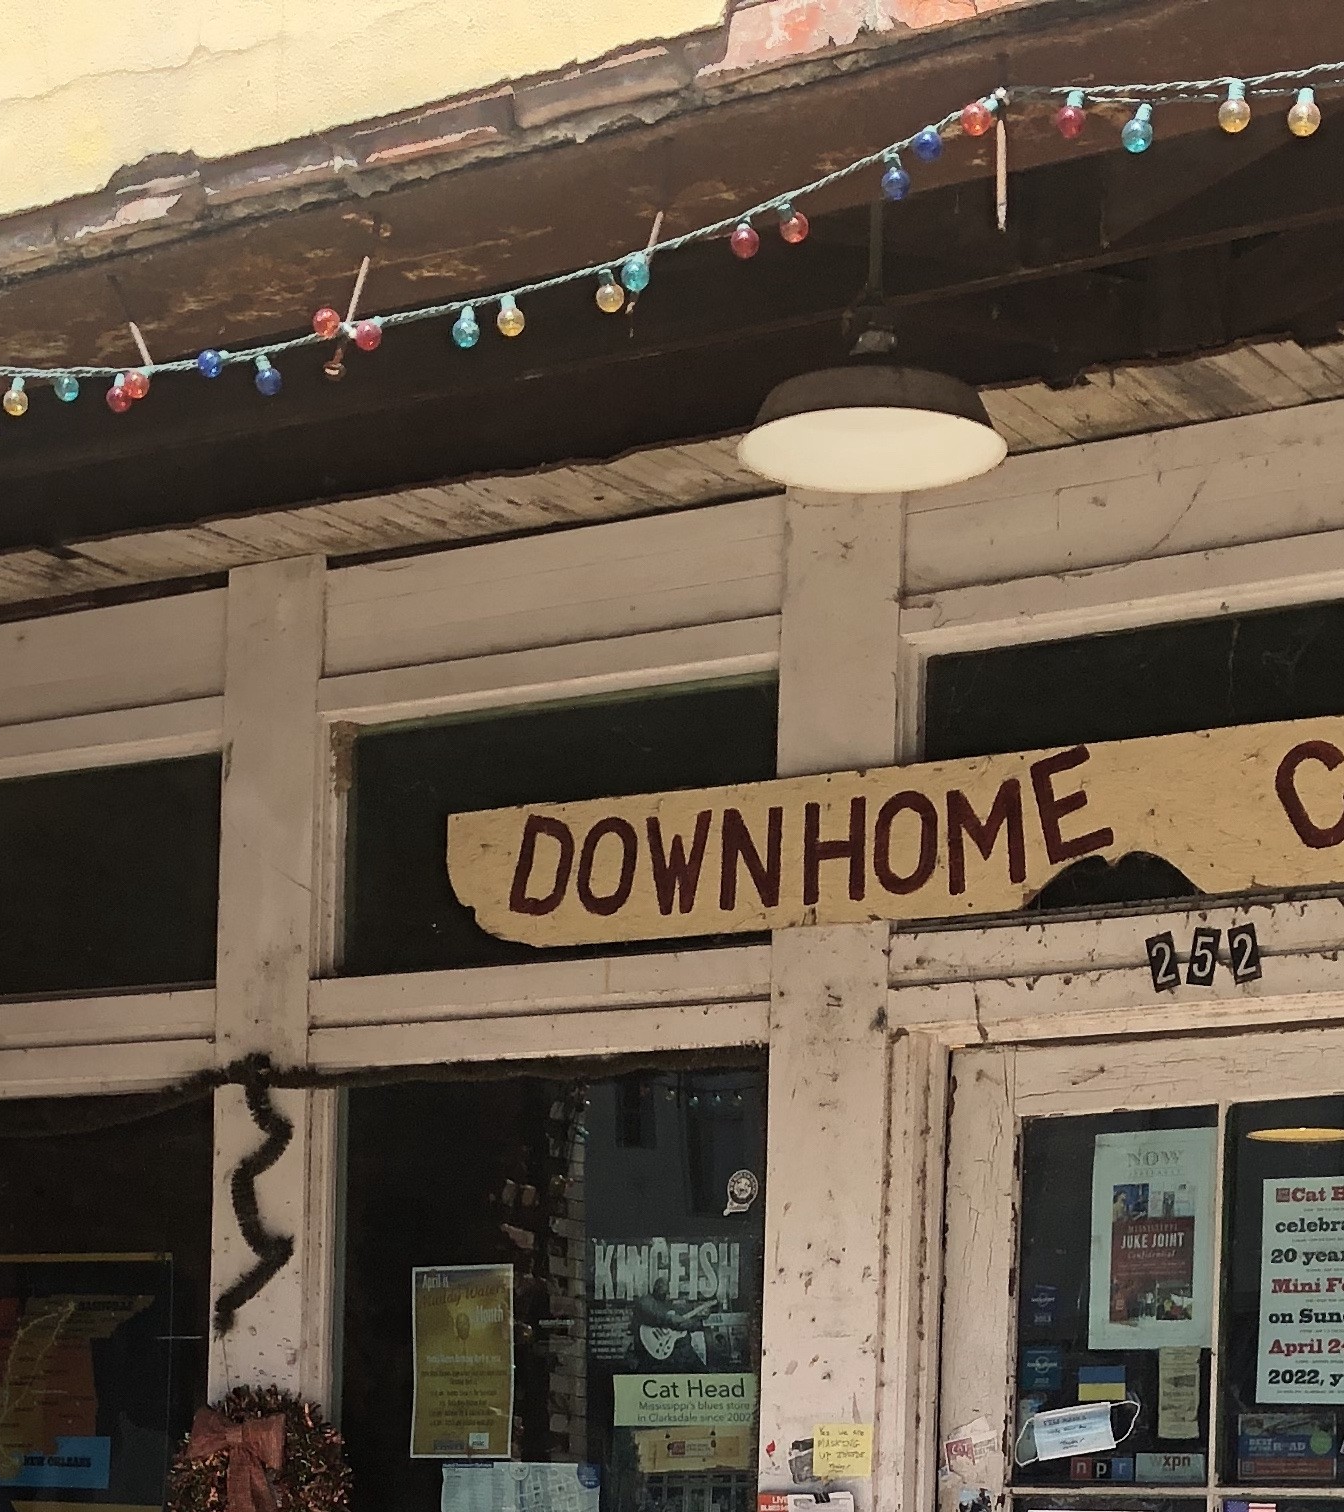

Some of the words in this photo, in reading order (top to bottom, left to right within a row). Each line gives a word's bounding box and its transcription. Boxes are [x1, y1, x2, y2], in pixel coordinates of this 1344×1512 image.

[510, 746, 1113, 916] DOWNHOME
[1151, 929, 1259, 988] 252
[1291, 1186, 1327, 1202] Cat
[1120, 1233, 1148, 1249] JUKE
[1151, 1232, 1185, 1248] JOINT
[1271, 1248, 1297, 1263] 20
[595, 1237, 740, 1300] KINGFISH
[1271, 1278, 1321, 1294] Mini
[1268, 1311, 1294, 1324] on
[1268, 1339, 1323, 1356] April
[1268, 1369, 1324, 1386] 2022,
[642, 1379, 680, 1399] Cat
[687, 1377, 745, 1399] Head
[639, 1401, 695, 1412] Mississippi's
[698, 1401, 724, 1410] blues
[726, 1401, 750, 1411] store
[1075, 1460, 1127, 1478] npr
